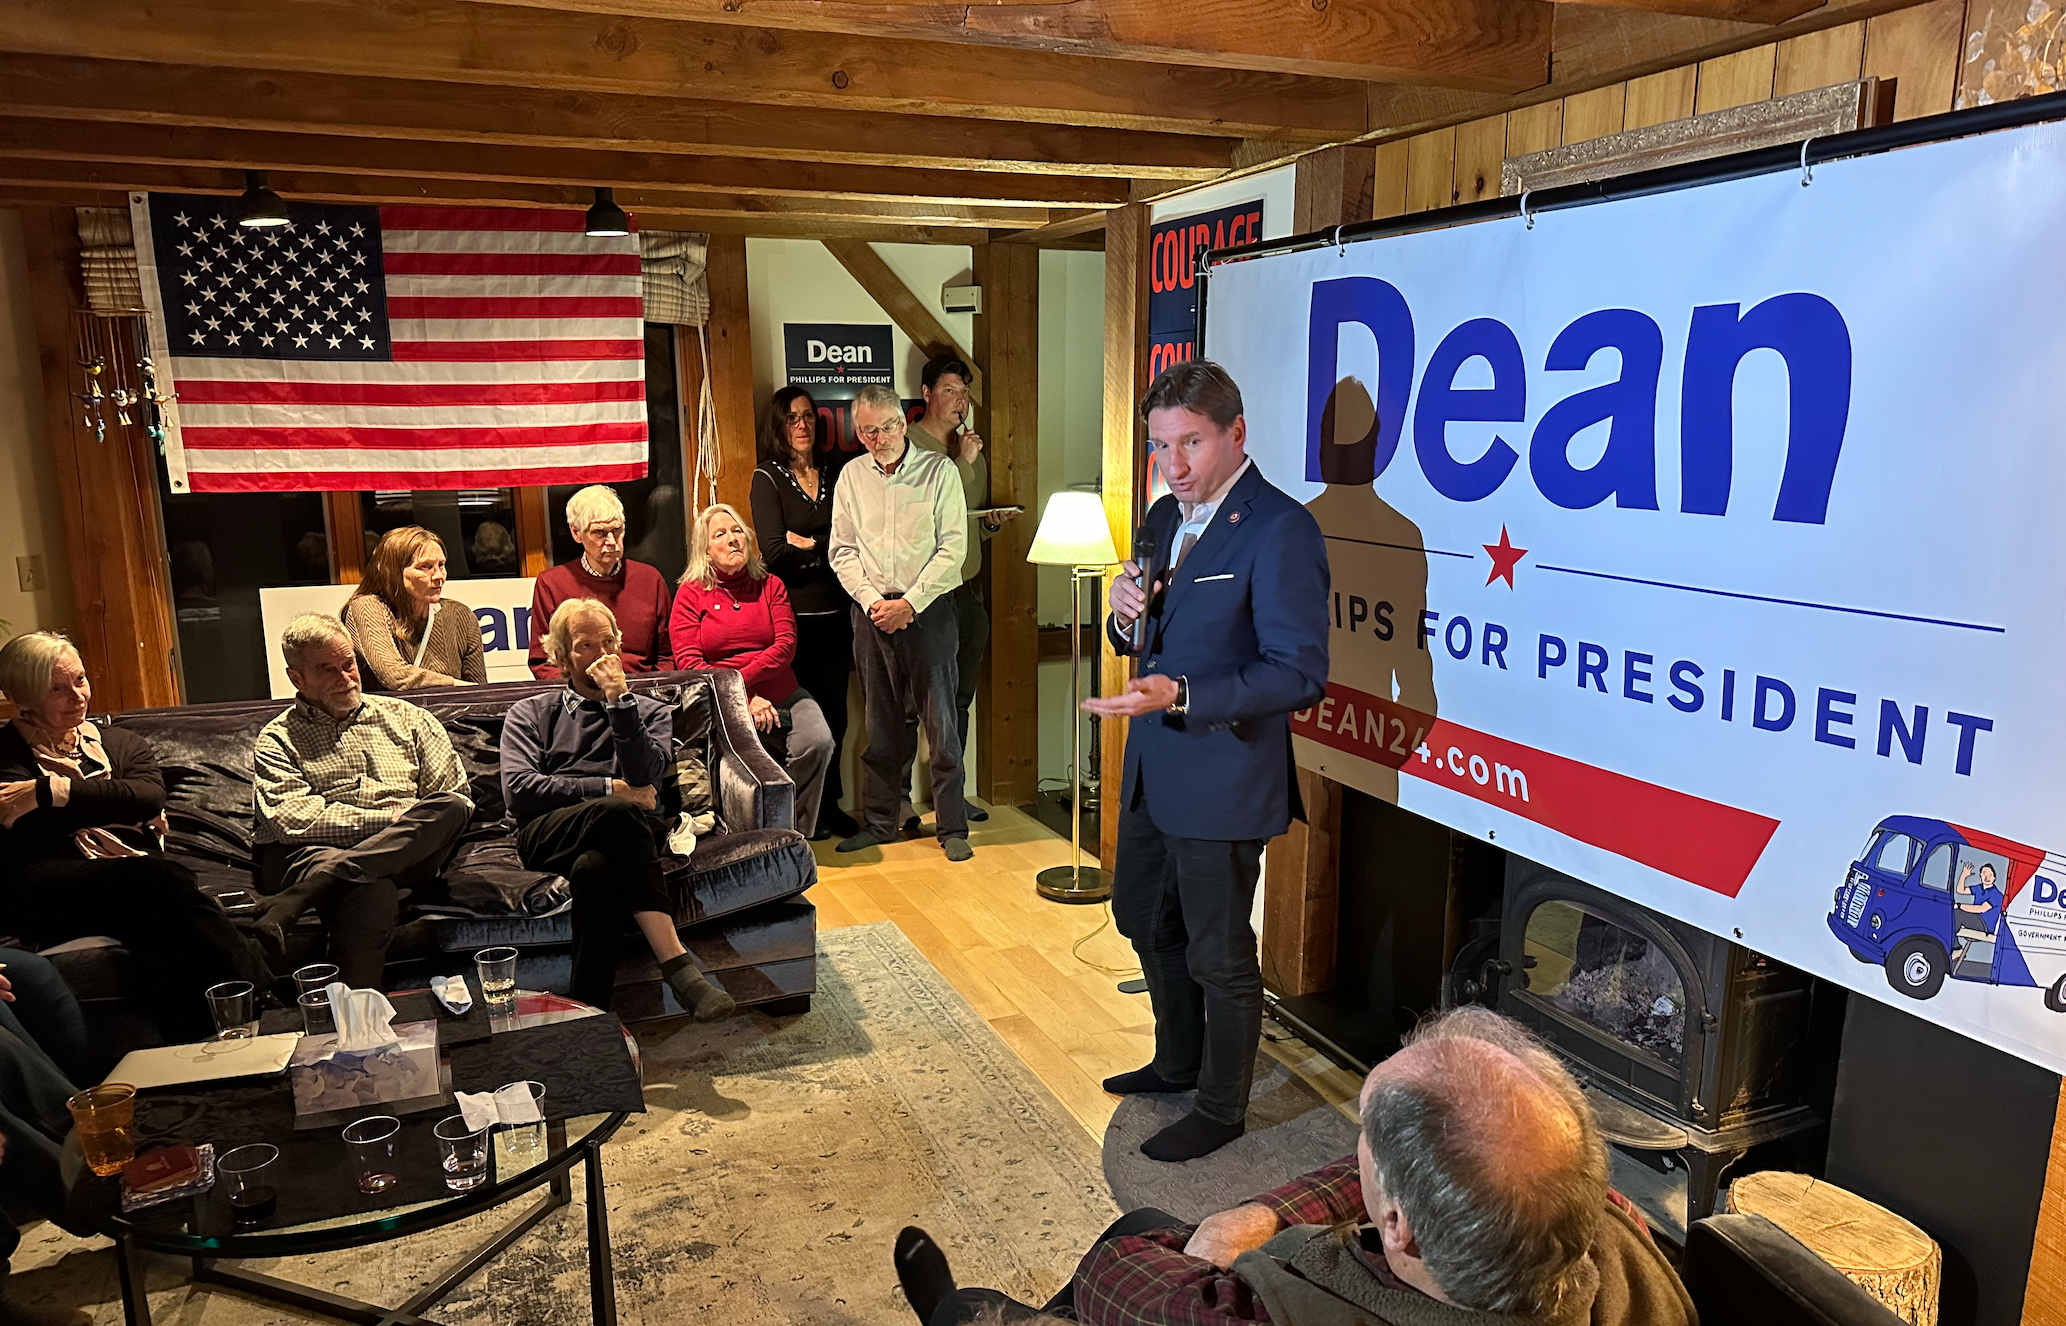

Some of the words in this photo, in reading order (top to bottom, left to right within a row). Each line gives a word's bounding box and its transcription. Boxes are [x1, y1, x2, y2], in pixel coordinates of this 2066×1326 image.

[806, 339, 873, 364] Dean
[789, 375, 827, 384] PHILLIPS
[828, 375, 845, 384] FOR
[846, 375, 891, 384] PRESIDENT
[1304, 276, 1852, 525] Dean
[1417, 609, 1509, 671] FOR
[1537, 632, 1994, 777] PRESIDENT
[2029, 907, 2062, 920] PHILLIPS
[2018, 929, 2062, 941] GOVERNMENT
